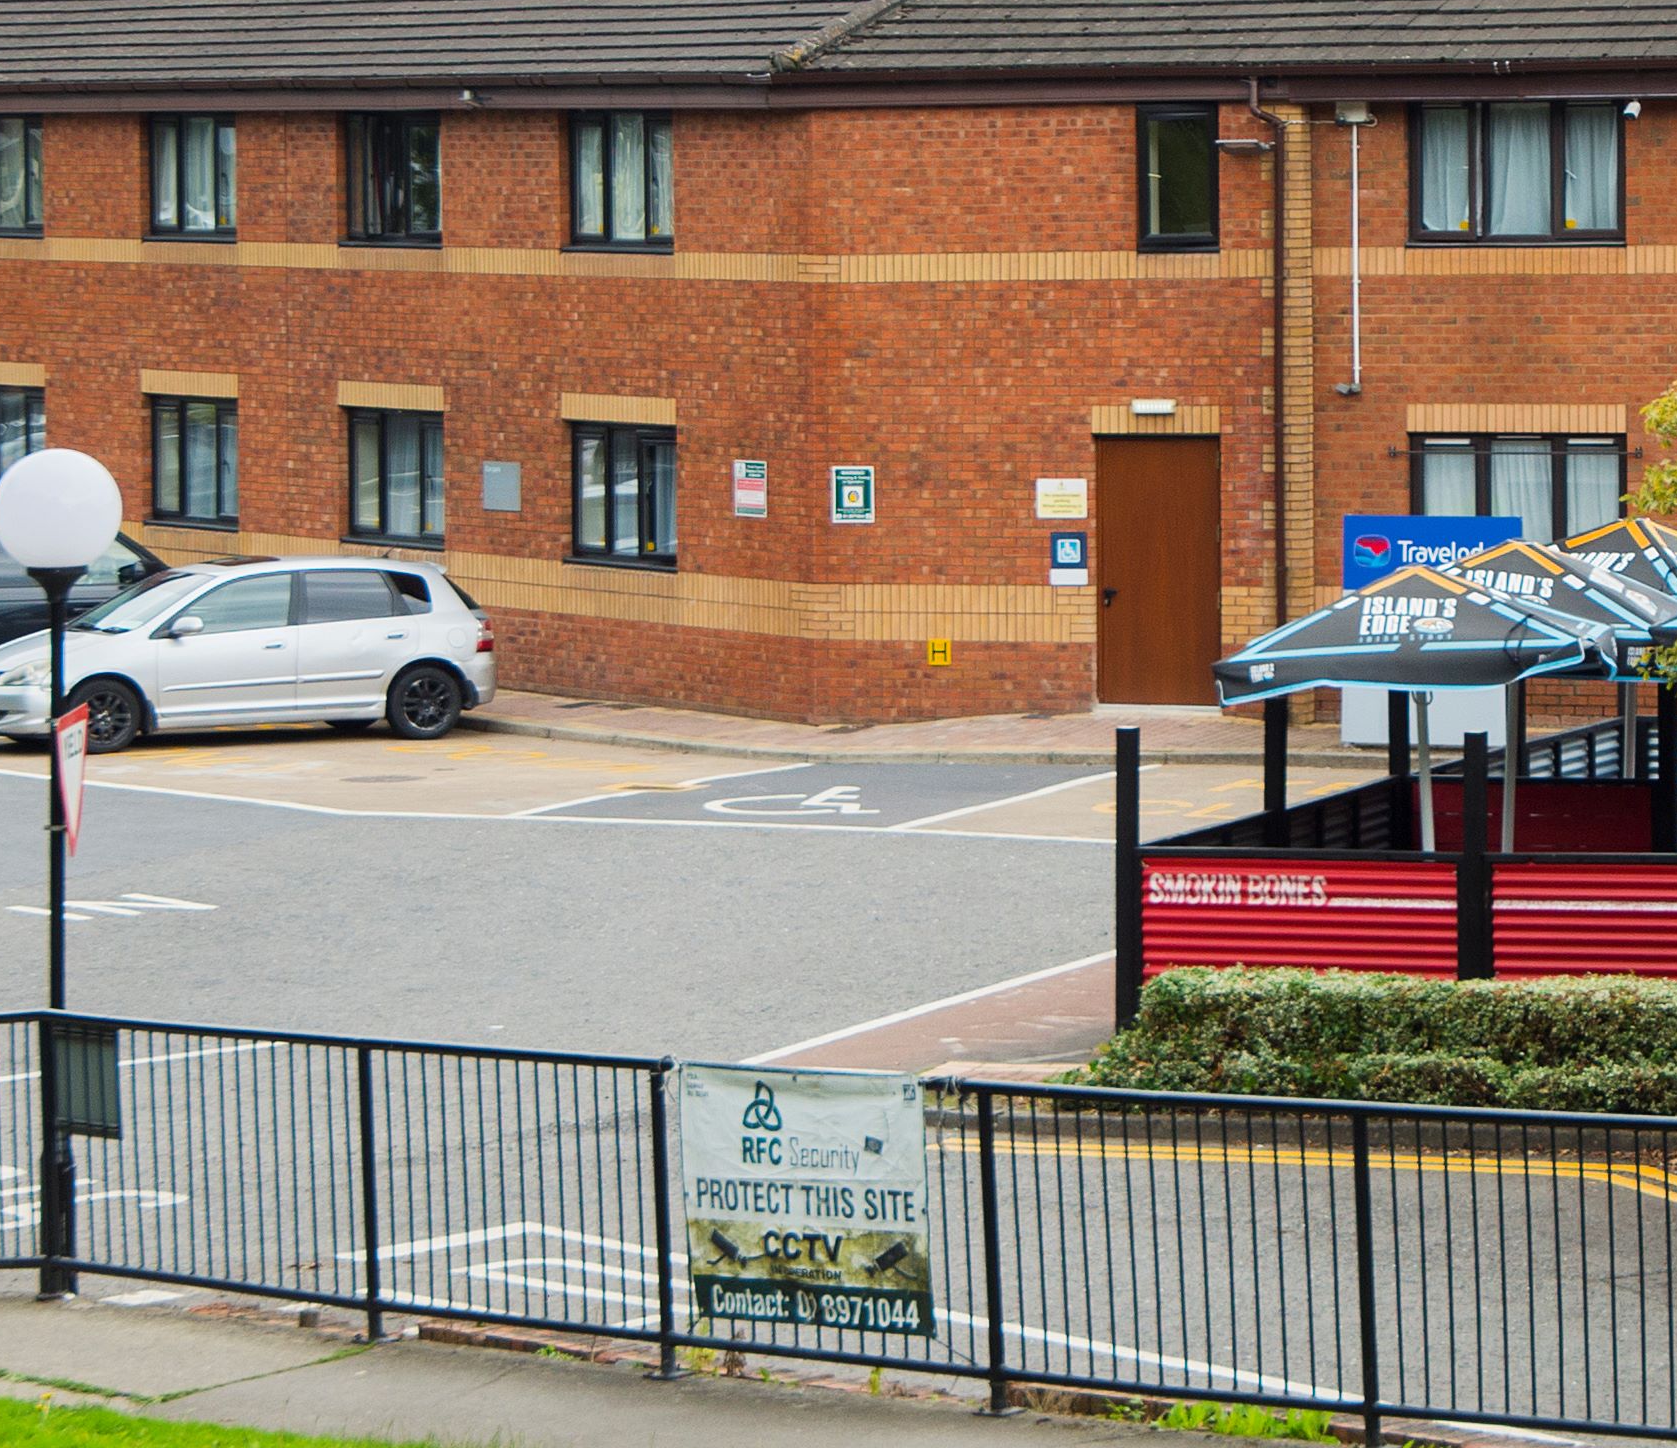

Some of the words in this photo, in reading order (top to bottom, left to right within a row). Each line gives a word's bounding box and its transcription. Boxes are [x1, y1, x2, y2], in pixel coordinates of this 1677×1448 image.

[1363, 596, 1457, 618] ISLAND'S
[1359, 615, 1411, 635] EDGE
[1149, 872, 1242, 905] SMOKIN
[1246, 874, 1328, 907] BONES
[742, 1136, 783, 1166] RFC
[789, 1136, 860, 1176] Security
[697, 1177, 794, 1214] PROTECT
[801, 1185, 855, 1219] THIS
[864, 1188, 916, 1222] SITE
[763, 1229, 843, 1262] CCTV
[712, 1284, 790, 1317] Contact:
[822, 1294, 921, 1329] 8971044
